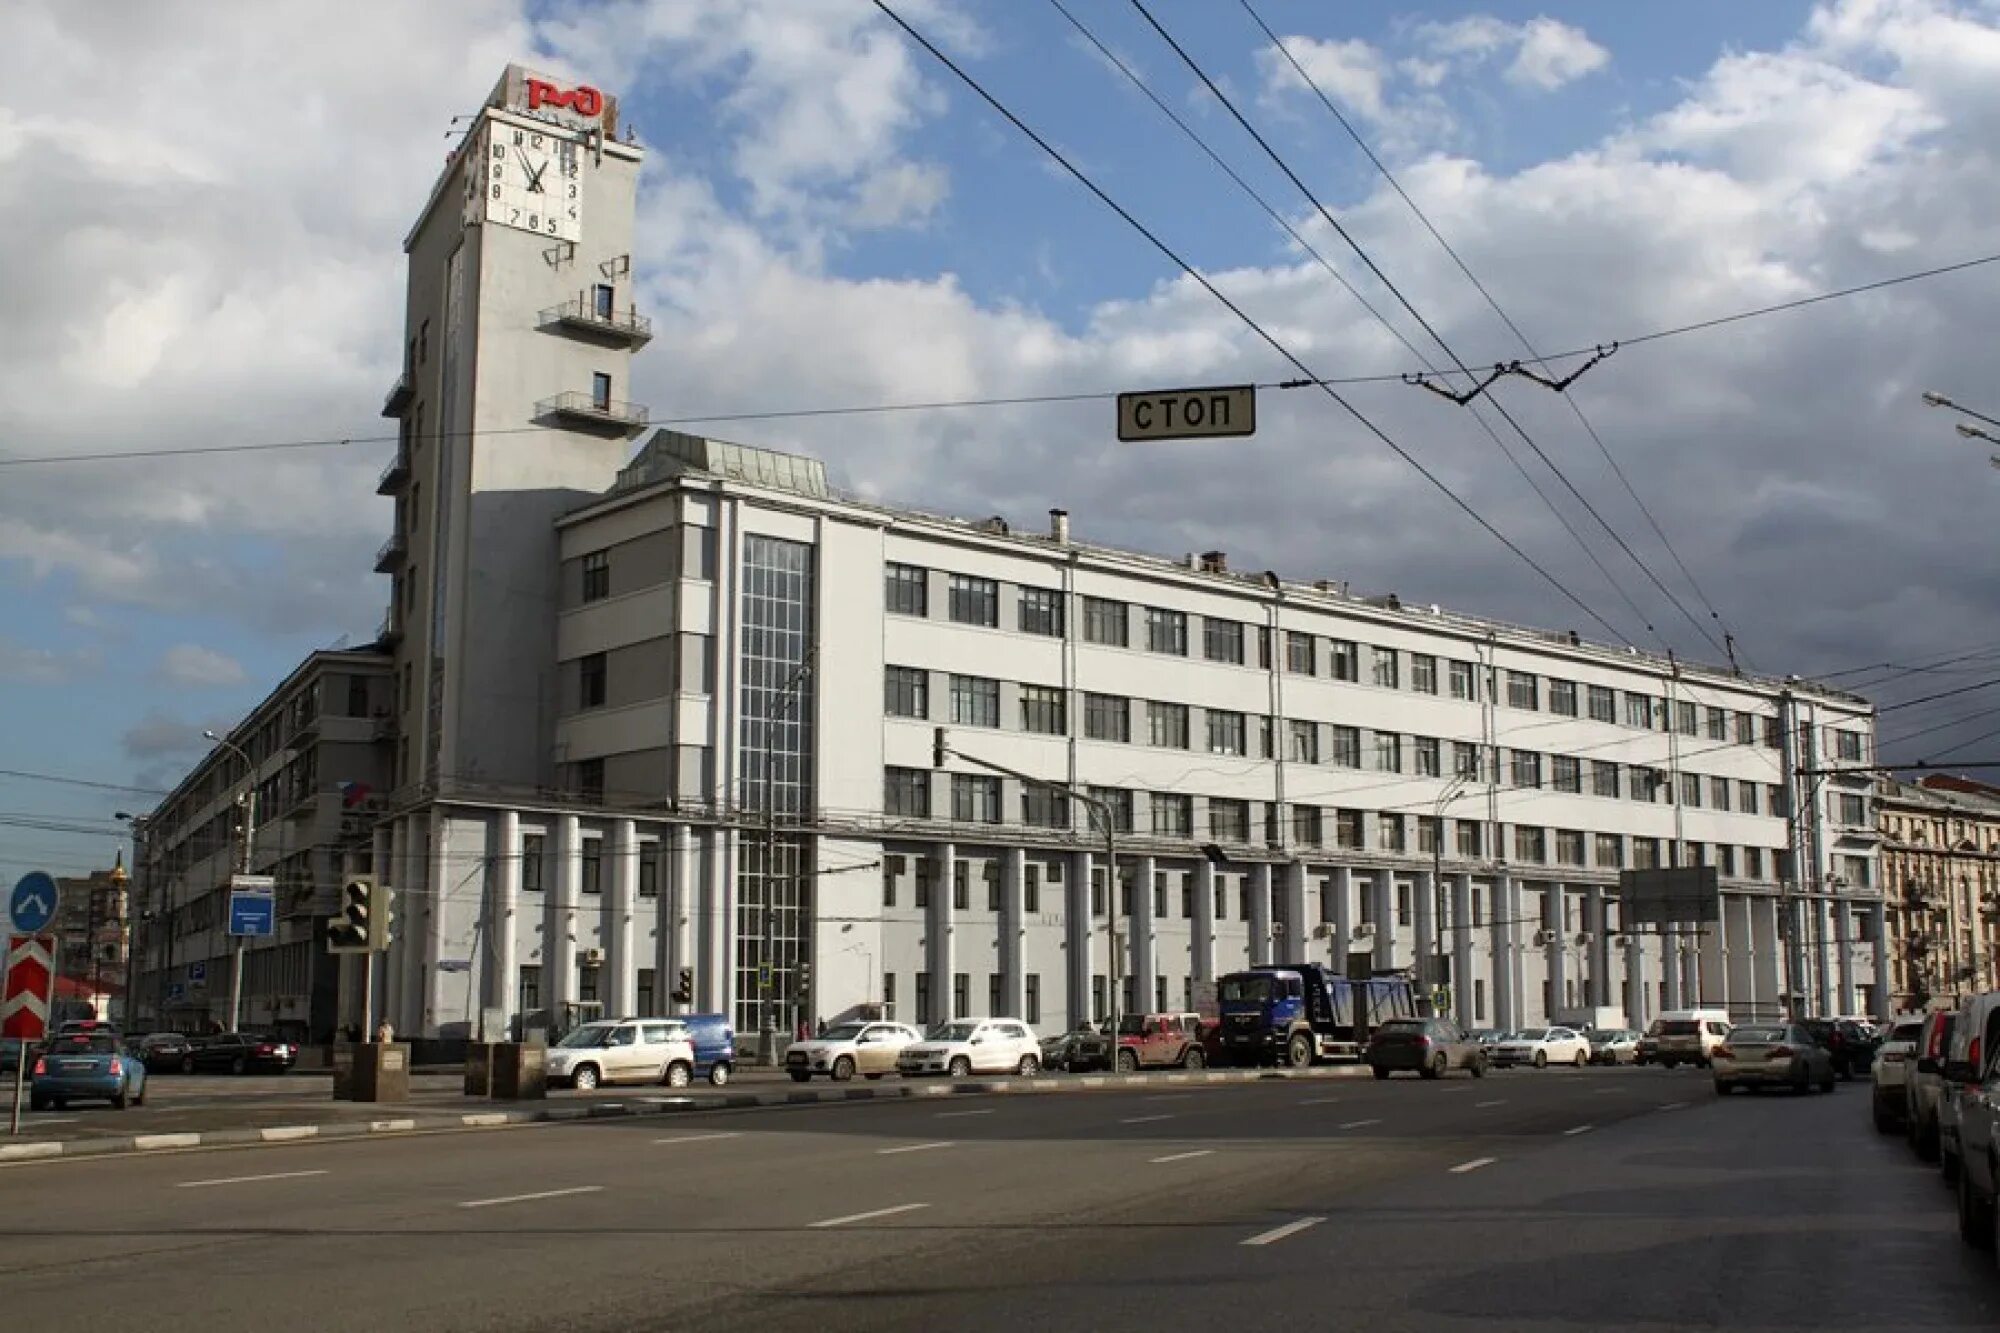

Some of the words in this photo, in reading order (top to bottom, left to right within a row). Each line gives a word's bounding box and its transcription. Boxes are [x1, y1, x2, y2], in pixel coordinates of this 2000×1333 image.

[492, 184, 501, 200] 8
[568, 184, 577, 199] 3
[510, 207, 521, 225] 7
[548, 218, 557, 234] 5
[1135, 395, 1230, 430] СТОП
